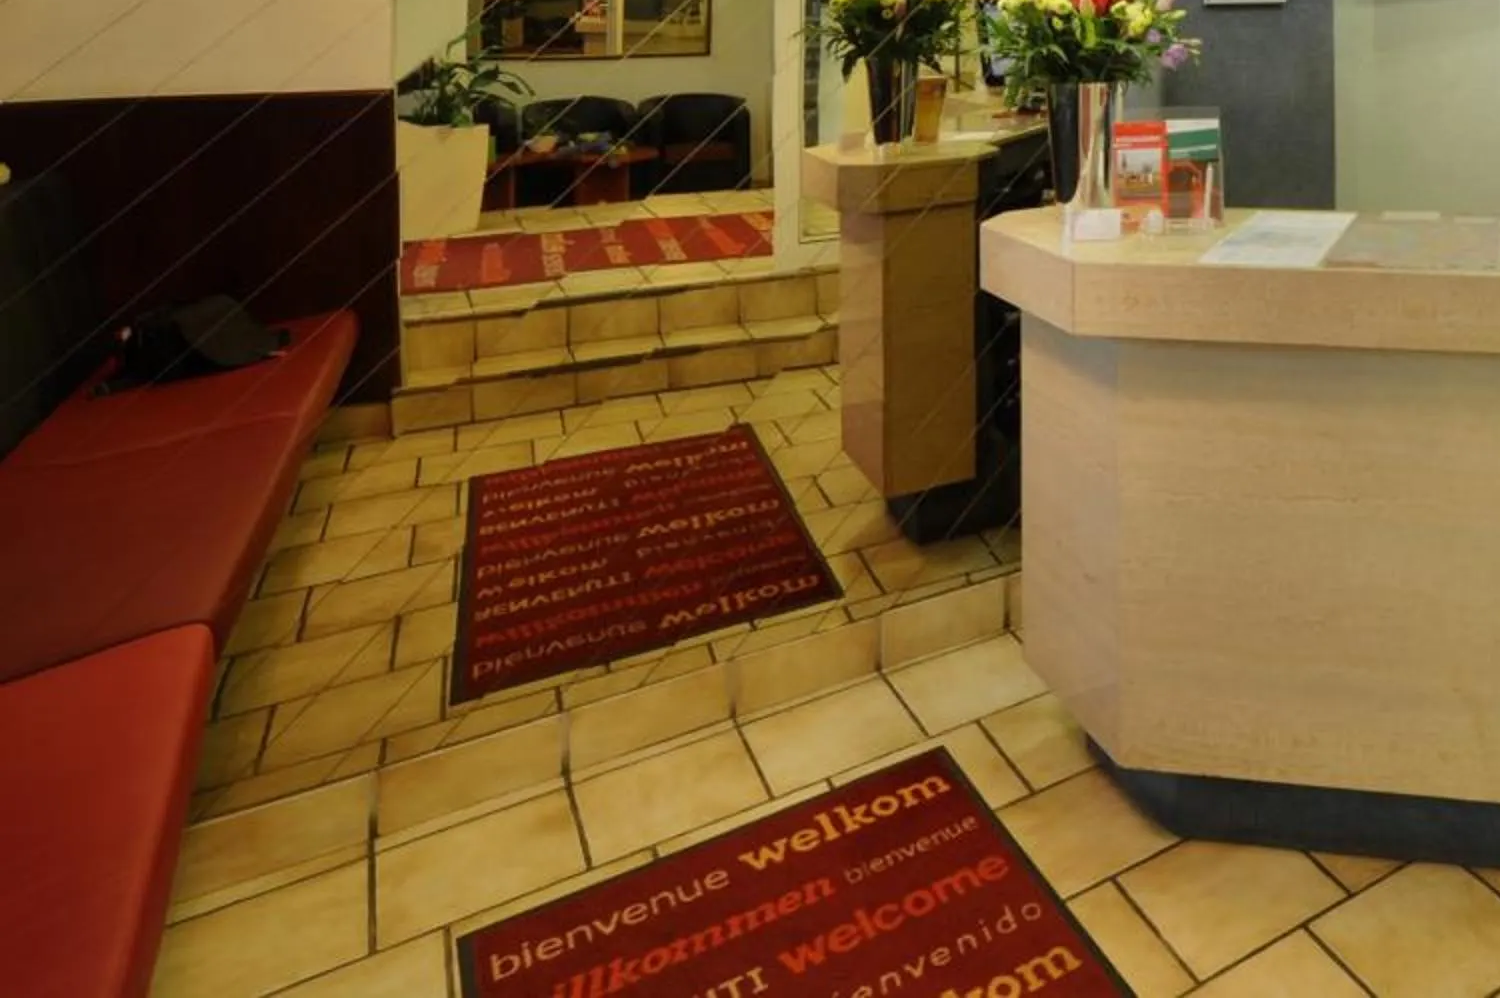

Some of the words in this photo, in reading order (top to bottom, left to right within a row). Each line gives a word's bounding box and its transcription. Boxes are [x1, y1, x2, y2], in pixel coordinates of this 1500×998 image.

[488, 869, 730, 982] bienvenue
[738, 774, 951, 871] welkom
[552, 876, 837, 998] illkommen
[843, 814, 980, 886] bienvenue
[777, 854, 1010, 976] welcome
